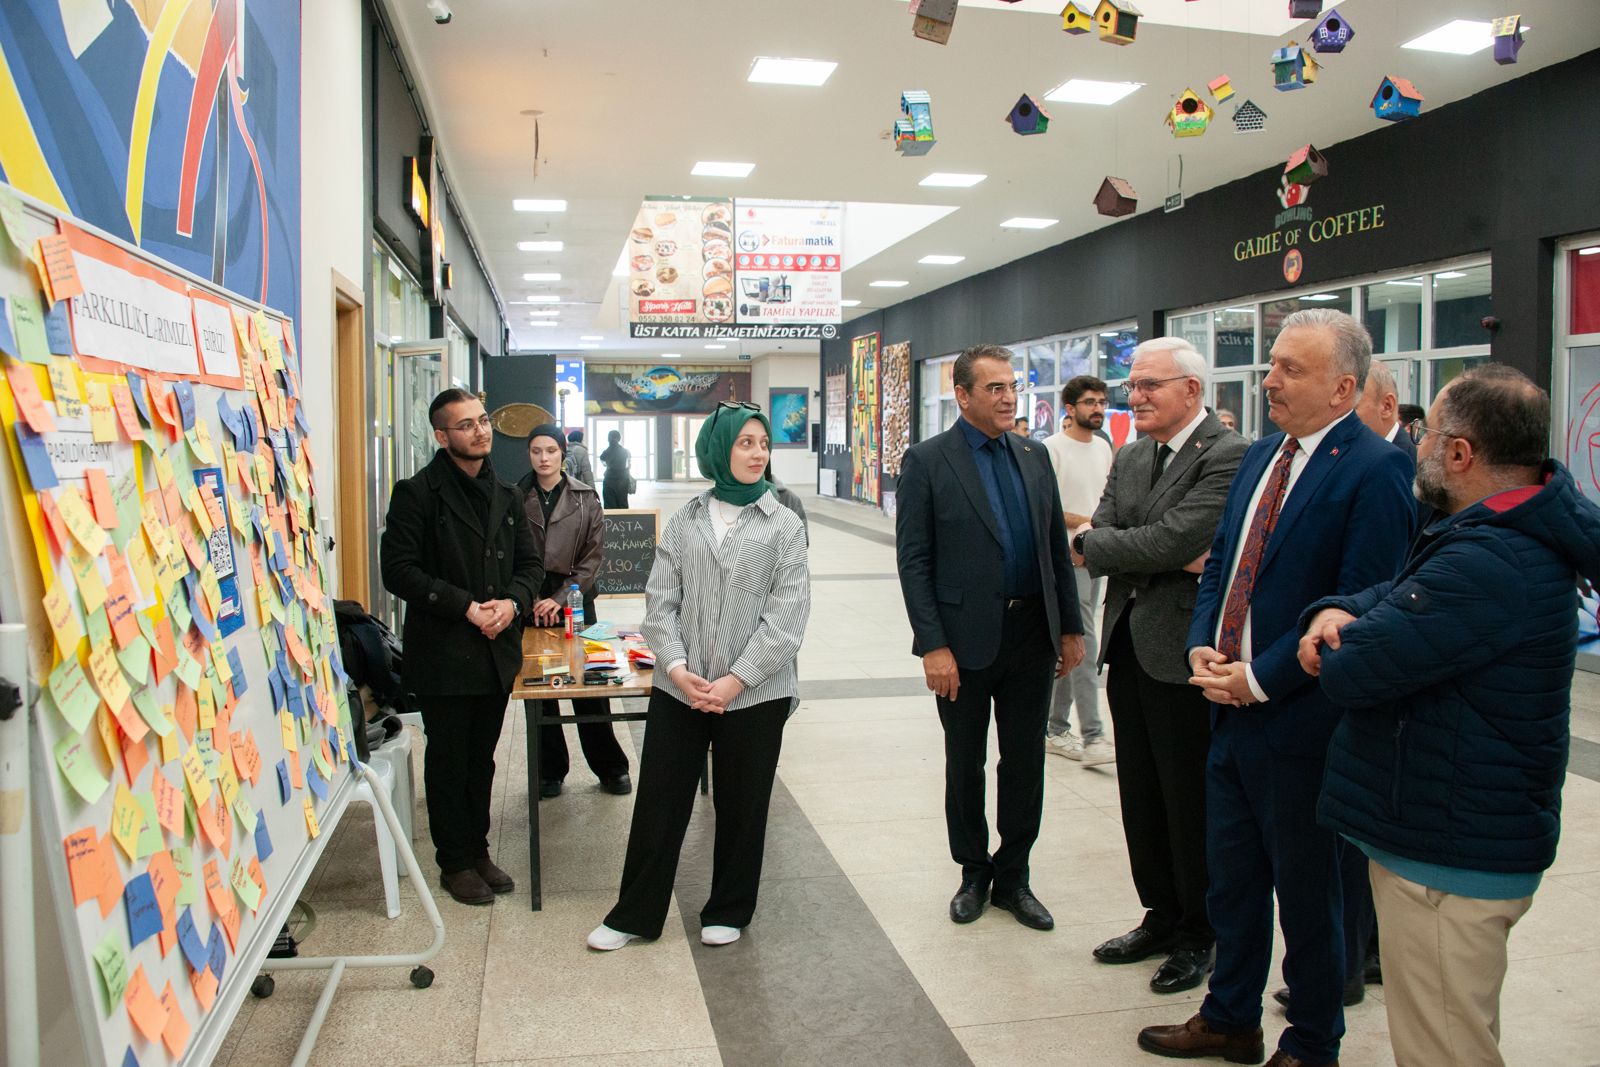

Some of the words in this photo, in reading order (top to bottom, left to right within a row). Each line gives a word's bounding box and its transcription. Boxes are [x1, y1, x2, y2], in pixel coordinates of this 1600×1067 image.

[1275, 206, 1313, 229] BOWLING
[771, 233, 834, 246] Faturamatik
[1234, 231, 1282, 262] GAME
[1285, 228, 1302, 246] OF
[1308, 205, 1385, 243] COFFEE
[763, 306, 797, 317] TAMİRİ
[634, 324, 659, 337] ÜST
[661, 326, 700, 337] KATTA
[604, 518, 643, 533] PASTA
